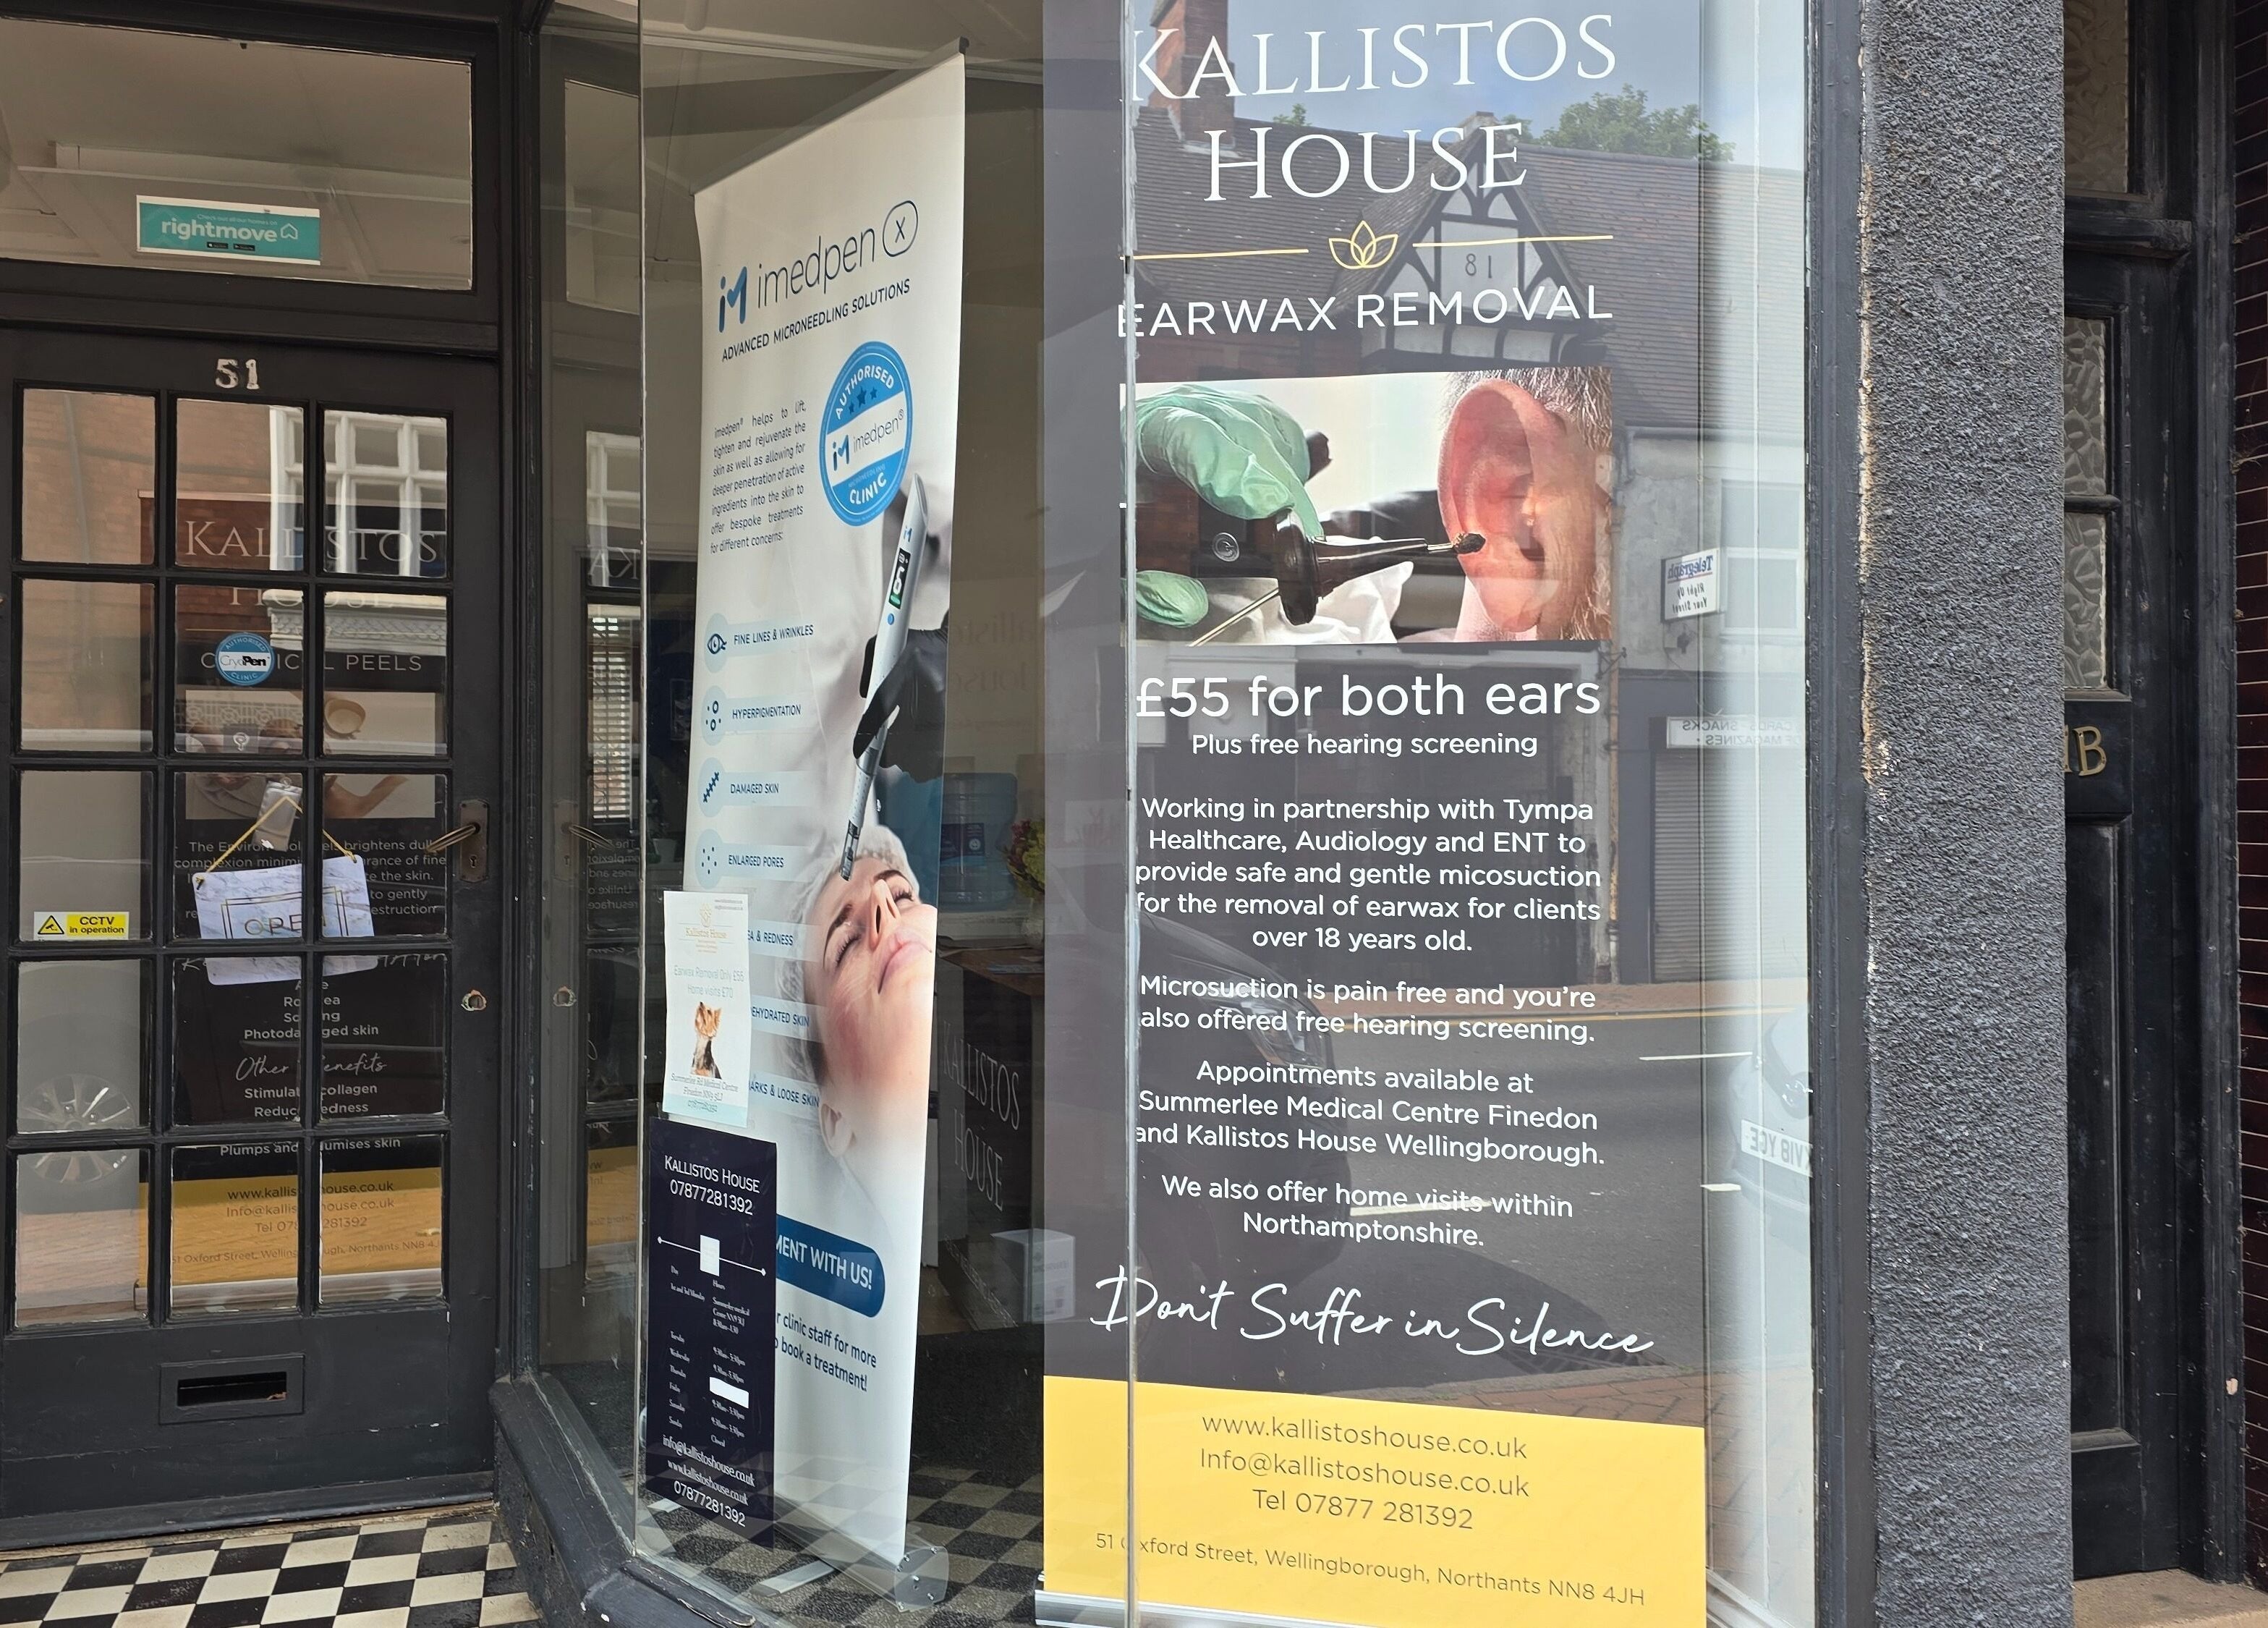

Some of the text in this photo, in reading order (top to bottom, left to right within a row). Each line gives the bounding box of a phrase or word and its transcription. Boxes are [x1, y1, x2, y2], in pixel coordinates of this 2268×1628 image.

[1131, 14, 1615, 101] KALLISTOS
[1204, 122, 1526, 201] HOUSE
[161, 217, 278, 242] rightmove
[758, 229, 875, 308] imedpen
[722, 279, 910, 362] ADVANCED MICRONEEDLING SOLUTIONS
[1118, 285, 1613, 338] EARWAX REMOVAL
[216, 358, 260, 389] 51
[836, 365, 894, 420] AUTHORISED
[714, 422, 806, 459] tighten and rejuvenate the
[850, 472, 887, 504] CLINIC
[184, 520, 438, 564] KALLSTOS
[734, 624, 814, 645] FINE LINES & WRINKLES
[347, 655, 422, 671] PEELS
[732, 704, 802, 719] HYPERPIGMENTATION
[1136, 674, 1601, 717] £55 for both ears
[1192, 734, 1538, 758] Plus free hearing screening
[730, 784, 779, 794] DAMAGED SKIN
[1142, 797, 1593, 823] Working in partnership with Tympa
[344, 840, 405, 854] brightens
[1149, 830, 1586, 855] Healthcare, Audiology and ENT to
[382, 870, 434, 882] the skin.
[405, 855, 446, 866] of fine
[729, 855, 784, 868] ENLARGED PORES
[1135, 861, 1602, 888] provide safe and gentle micosuction
[387, 889, 428, 902] gently
[1136, 891, 1600, 921] for the removal of earwax for clients
[80, 916, 114, 925] CCTV
[756, 930, 762, 942] &
[763, 931, 794, 946] REDNESS
[1253, 928, 1473, 952] over 18 years old.
[1140, 975, 1298, 1000] Microsuction
[1307, 978, 1325, 1001] is
[1334, 979, 1388, 1004] pain
[1396, 980, 1446, 1004] free
[1455, 984, 1504, 1006] and
[749, 1006, 810, 1027] EHYDRATED SKIN
[1140, 1009, 1595, 1046] also offered free hearing screening.
[235, 1054, 289, 1081] Other
[943, 1019, 1020, 1130] KALLISTOS
[1196, 1060, 1534, 1093] Appointments available at
[770, 1085, 776, 1097] &
[778, 1086, 799, 1104] LOOSE
[802, 1093, 820, 1108] SKIN
[1139, 1090, 1598, 1130] Summerlee Medical Centre Finedon
[954, 1108, 1003, 1212] HOUSE
[1136, 1124, 1605, 1167] and Kallistos House Wellingborough.
[665, 1155, 760, 1193] KALLISTOS HOUSE
[670, 1179, 753, 1216] 07877281392
[1162, 1174, 1573, 1218] We also offer home visits within
[1243, 1213, 1485, 1247] Northamptonshire.
[810, 1246, 846, 1279] WITH
[850, 1262, 872, 1290] US!
[1241, 1283, 1393, 1344] Suffer
[1405, 1308, 1458, 1340] in
[1456, 1297, 1654, 1356] Silence
[783, 1311, 877, 1368] clinic staff for more
[781, 1336, 867, 1391] book a treatment!
[1202, 1413, 1527, 1459] www.kallistoshouse.co.uk
[1201, 1448, 1529, 1497] Info@kallistoshouse.co.uk
[674, 1480, 746, 1527] 07877281392
[1252, 1488, 1473, 1530] Tel 07877 281392
[1097, 1532, 1113, 1550] 51
[1194, 1543, 1259, 1567] Street,
[1265, 1549, 1430, 1585] Wellingborough,
[1438, 1567, 1541, 1595] Northants
[1548, 1579, 1594, 1601] NN8
[1602, 1585, 1645, 1607] 4JH
